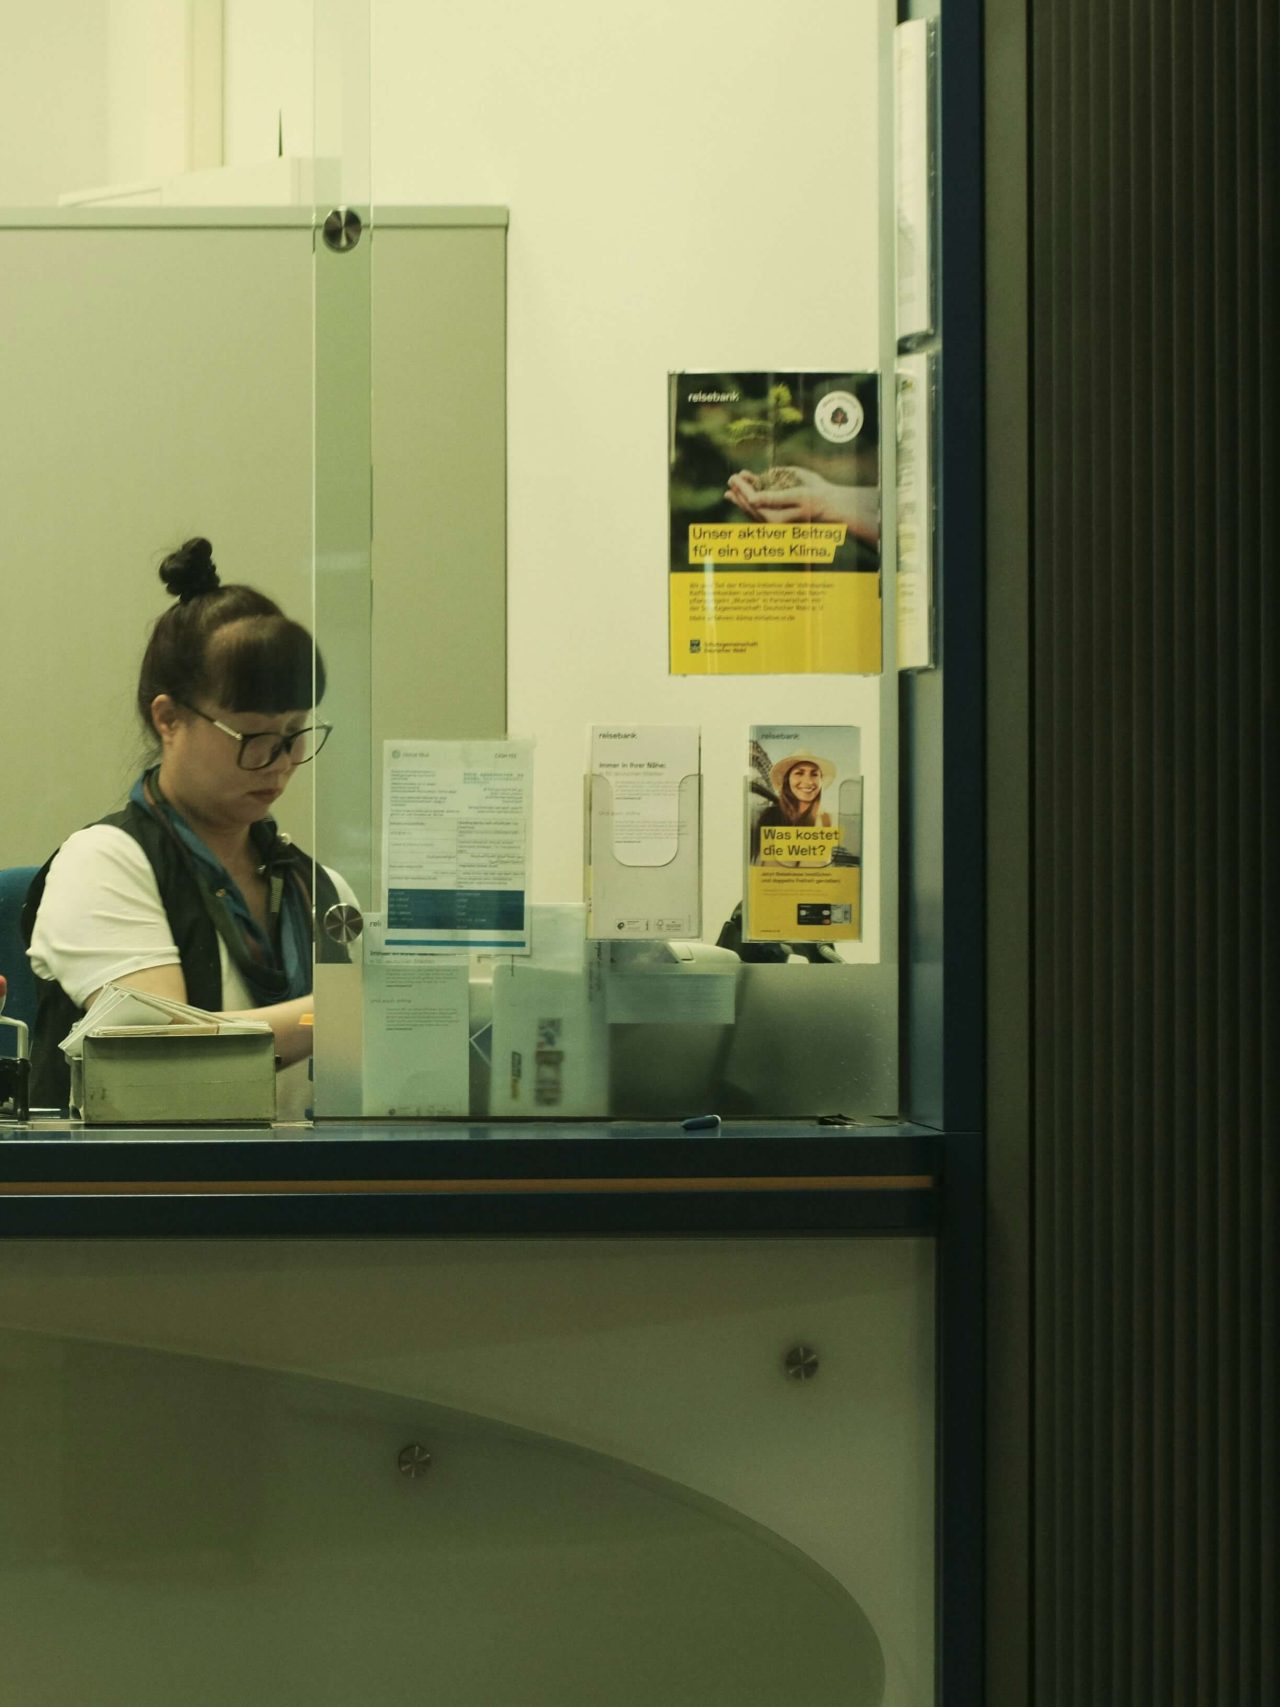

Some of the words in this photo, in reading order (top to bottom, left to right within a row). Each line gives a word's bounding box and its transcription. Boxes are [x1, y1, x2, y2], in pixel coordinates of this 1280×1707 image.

[688, 391, 739, 403] reisebank
[693, 527, 733, 539] Unser
[738, 527, 787, 539] aktiver
[792, 527, 842, 542] Beitrag
[693, 545, 713, 557] für
[718, 547, 738, 557] ein
[743, 546, 785, 560] gutes
[789, 545, 831, 557] Klima.
[763, 828, 791, 840] Was
[796, 828, 840, 840] kostet
[763, 844, 783, 856] die
[788, 844, 826, 856] Welt?
